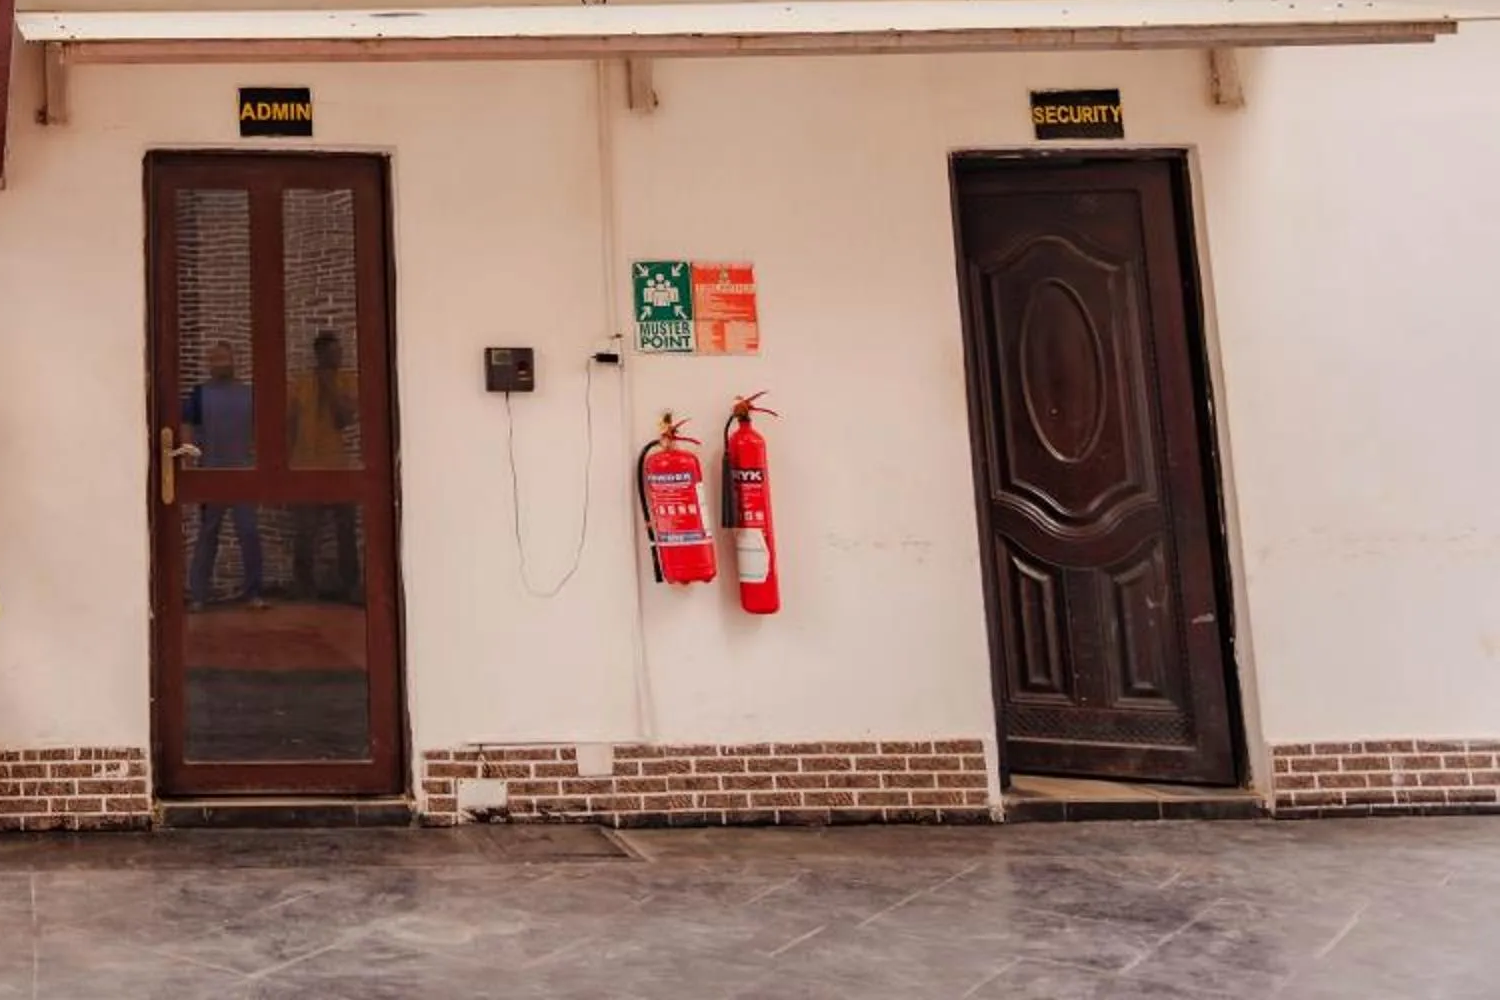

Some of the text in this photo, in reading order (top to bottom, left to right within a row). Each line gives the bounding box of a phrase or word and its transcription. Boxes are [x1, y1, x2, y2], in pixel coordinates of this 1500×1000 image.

[240, 101, 311, 121] ADMIN
[1032, 105, 1121, 124] SECURITY
[640, 321, 690, 335] MUSTER
[641, 336, 690, 348] POINT
